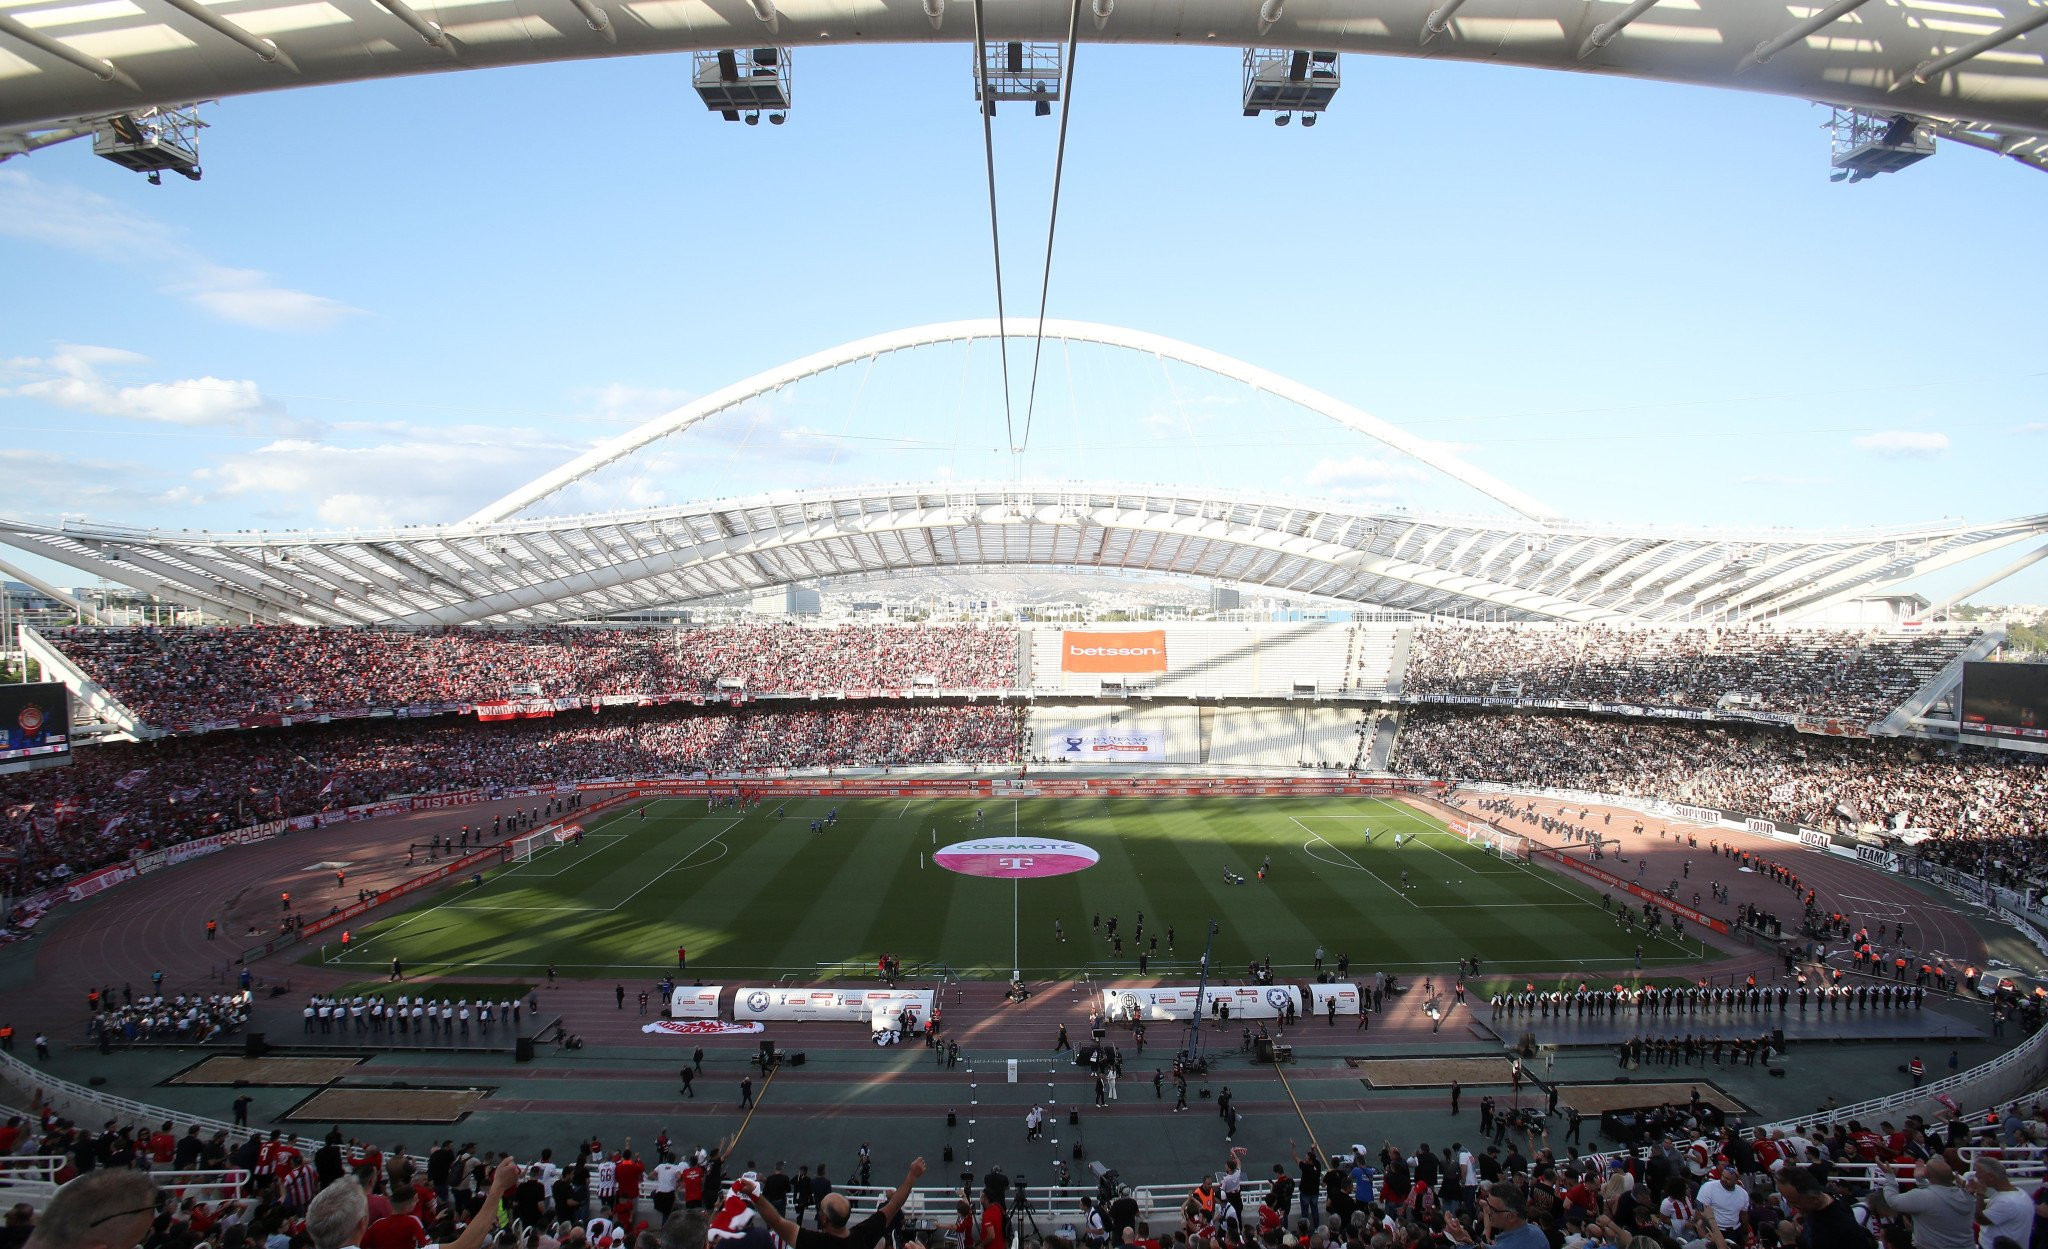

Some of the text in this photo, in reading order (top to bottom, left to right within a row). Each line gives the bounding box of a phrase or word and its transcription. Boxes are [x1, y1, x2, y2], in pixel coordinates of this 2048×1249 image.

[1070, 645, 1156, 656] betsson
[1676, 805, 1719, 823] SUPPORT
[1748, 820, 1773, 835] YOUR
[1800, 831, 1829, 849] LOCAL
[1857, 846, 1885, 864] TEAM
[1000, 857, 1033, 870] T
[261, 1147, 269, 1160] 9
[600, 1168, 612, 1182] 66
